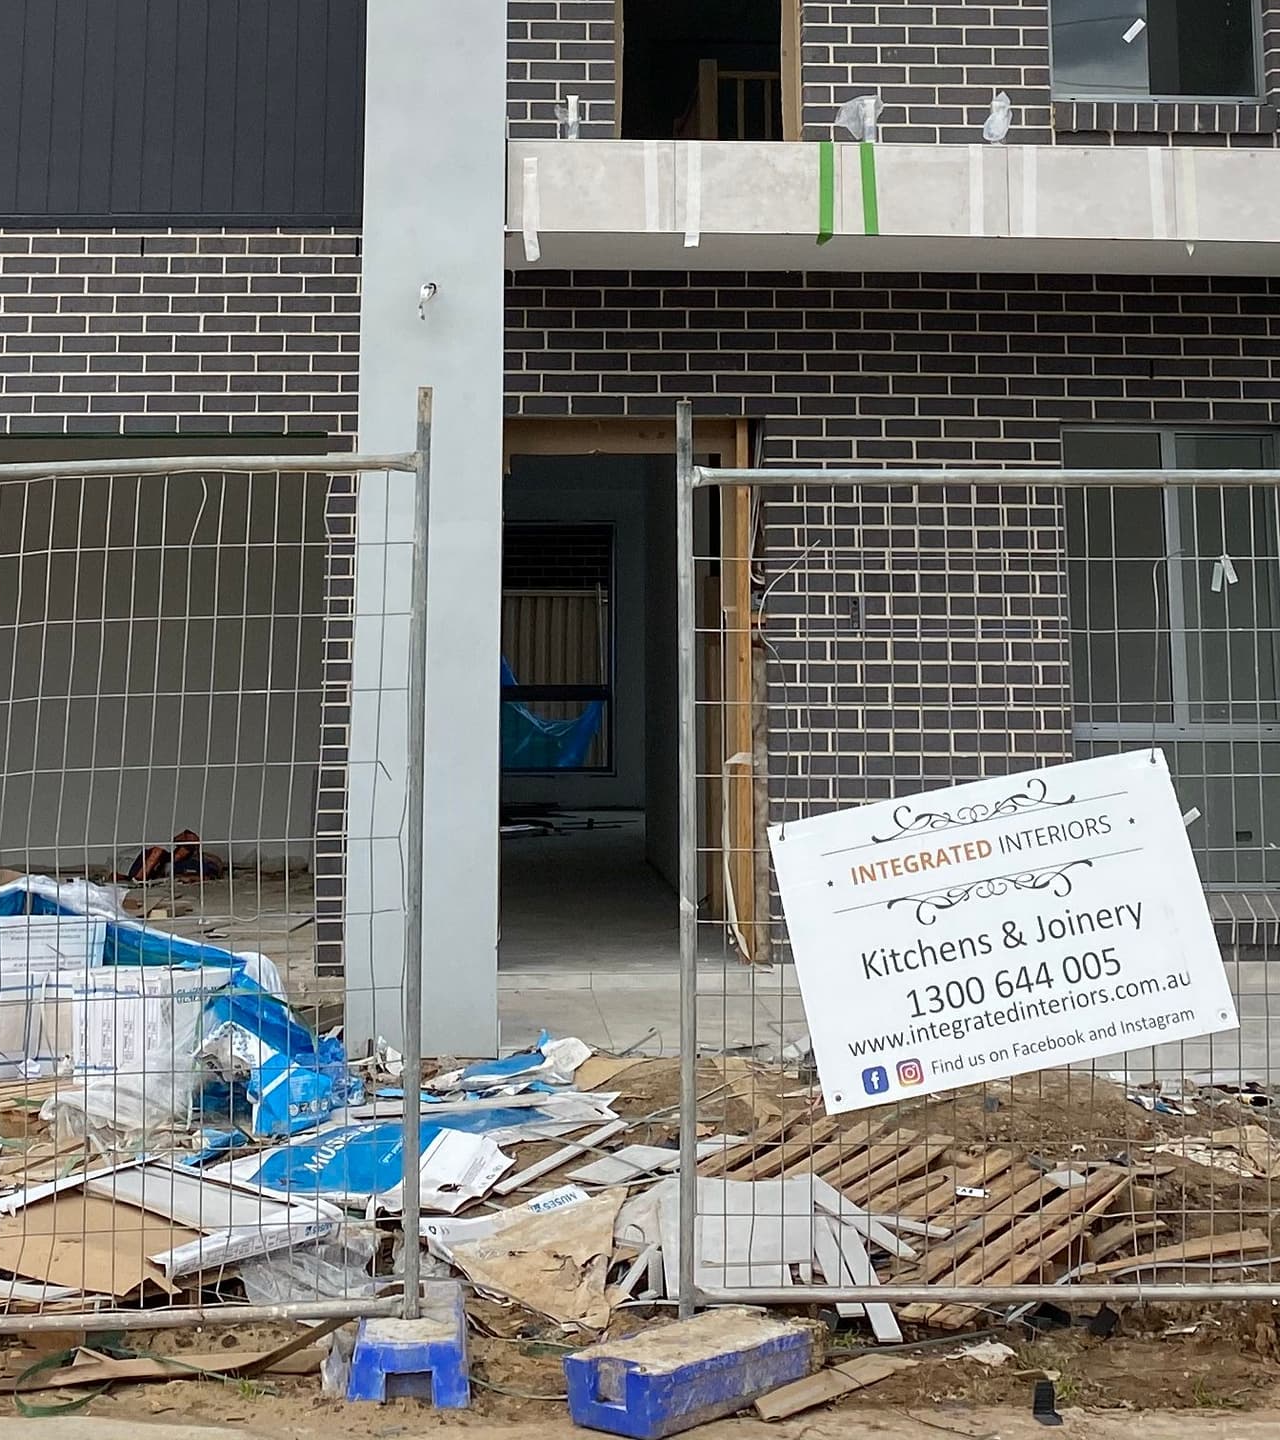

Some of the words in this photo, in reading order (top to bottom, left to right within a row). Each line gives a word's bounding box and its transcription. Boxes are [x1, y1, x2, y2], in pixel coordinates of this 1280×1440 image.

[851, 839, 992, 886] INTEGRATED
[998, 814, 1112, 855] INTERIORS
[861, 933, 993, 979] Kitchens
[1002, 920, 1027, 949] &
[1036, 901, 1142, 943] Joinery
[848, 970, 1191, 1057] www.integratedinteriors.com.au
[906, 976, 985, 1018] 1300
[995, 961, 1054, 999] 644
[1062, 947, 1121, 985] 005
[931, 1058, 964, 1075] Find
[968, 1053, 986, 1067] us
[989, 1048, 1009, 1063] on
[1012, 1028, 1086, 1057] Facebook
[1089, 1021, 1117, 1042] and
[1119, 1009, 1196, 1036] Instagram
[542, 1191, 578, 1210] MUSES
